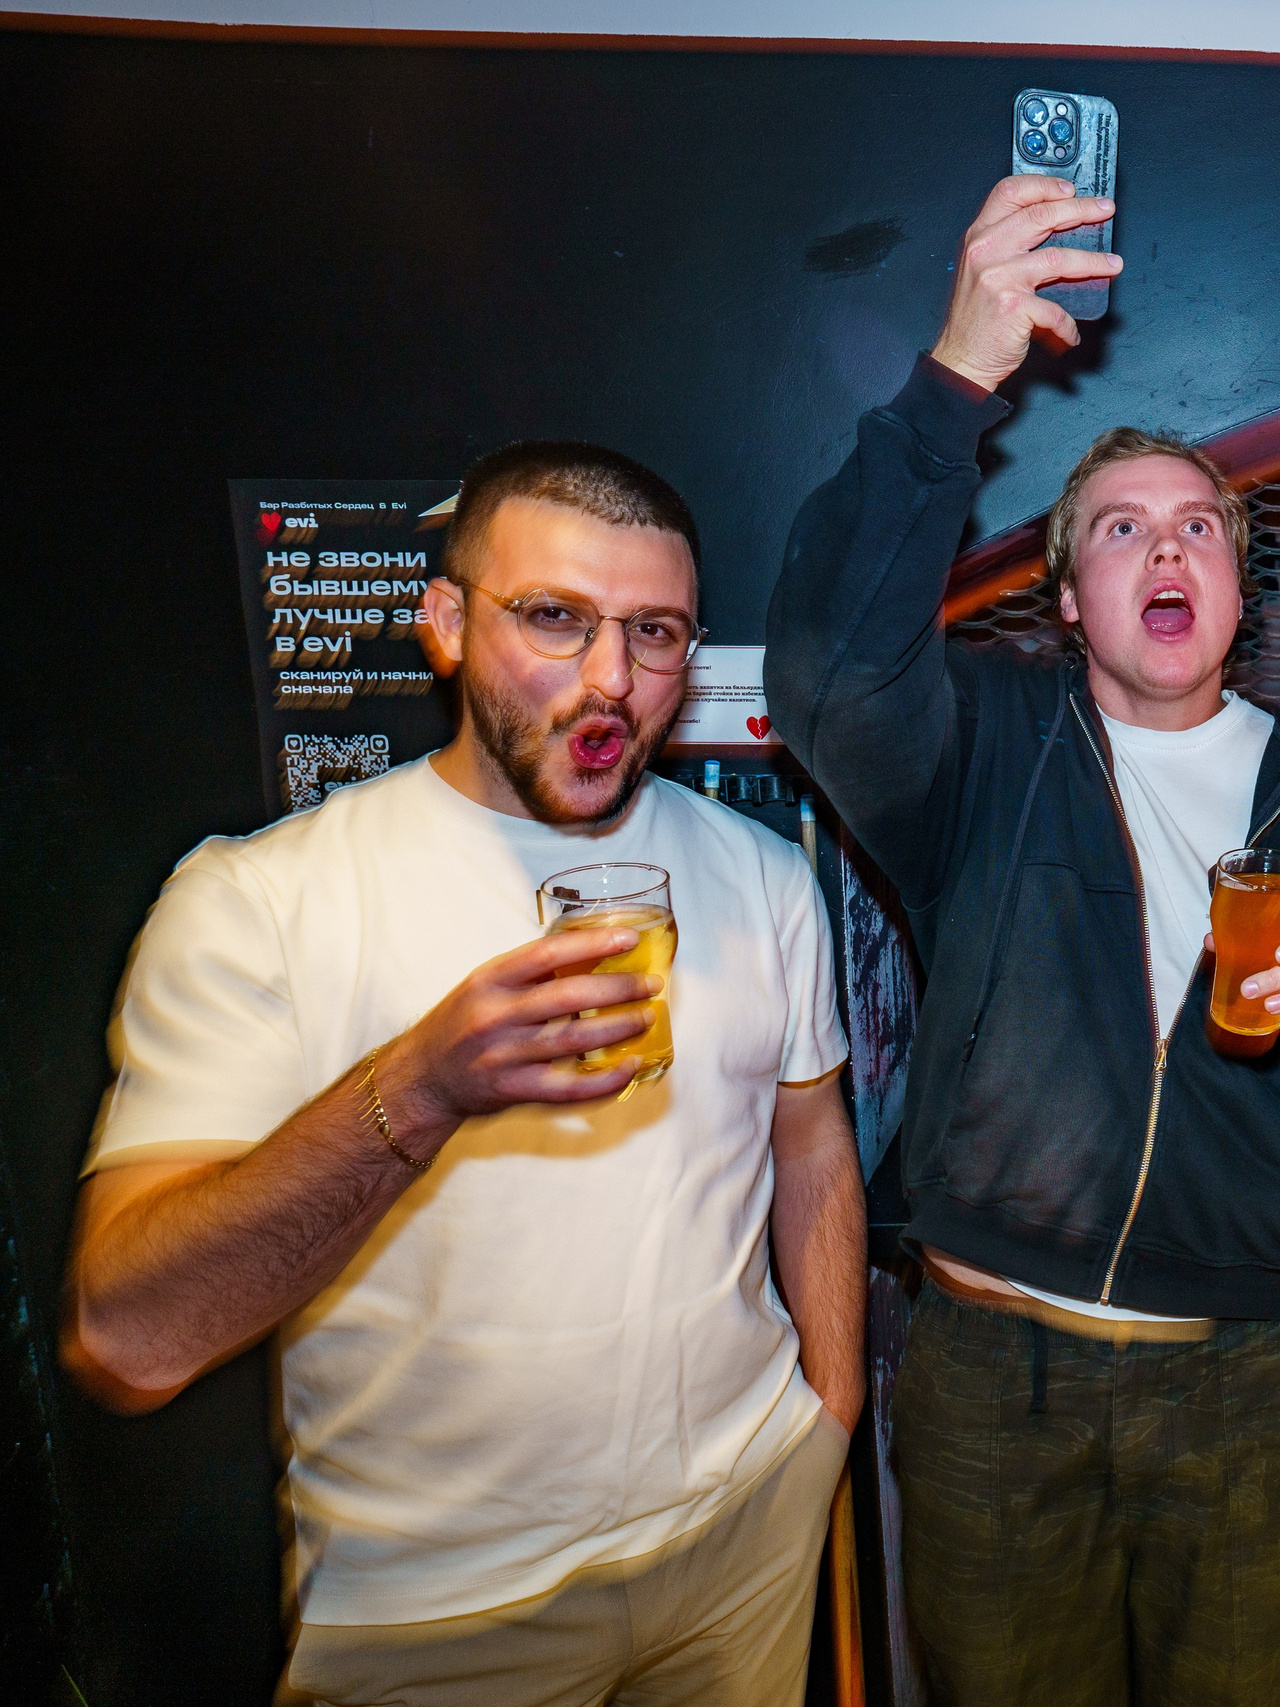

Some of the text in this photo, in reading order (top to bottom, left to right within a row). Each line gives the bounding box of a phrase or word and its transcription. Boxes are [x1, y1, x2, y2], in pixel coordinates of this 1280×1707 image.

[259, 501, 280, 511] Бар
[281, 501, 333, 509] Разбитых
[334, 502, 374, 511] Сердец
[391, 501, 407, 510] Evi
[284, 512, 319, 529] evi
[266, 551, 427, 568] не звони
[272, 608, 385, 631] лучше
[275, 631, 352, 652] в evi
[279, 669, 434, 682] сканируй и начни
[281, 684, 354, 694] сначала
